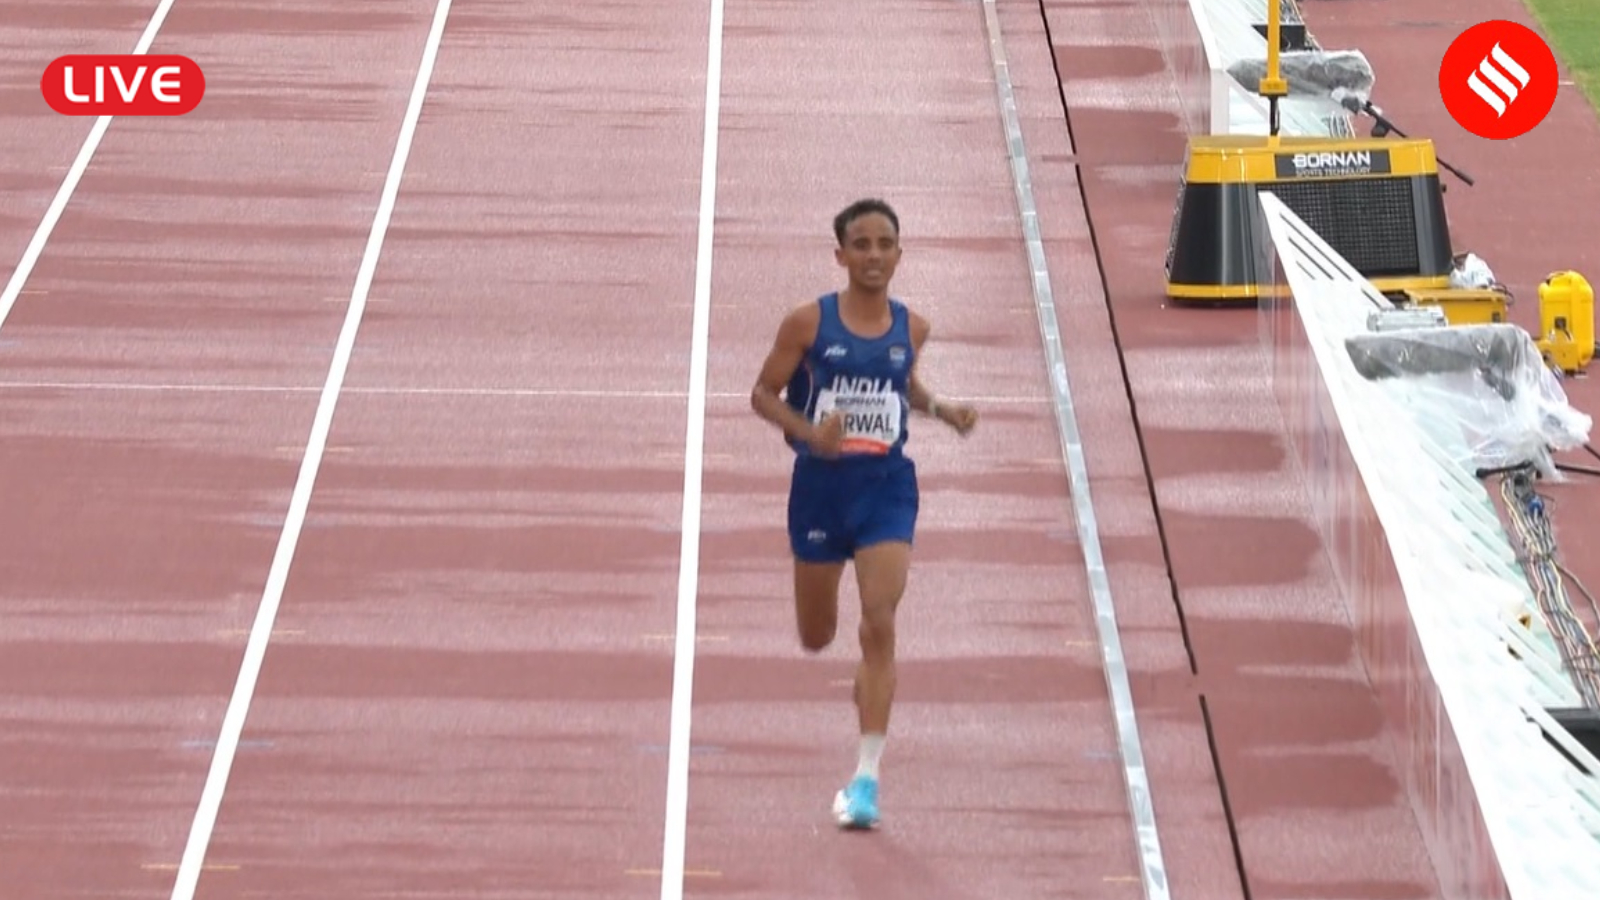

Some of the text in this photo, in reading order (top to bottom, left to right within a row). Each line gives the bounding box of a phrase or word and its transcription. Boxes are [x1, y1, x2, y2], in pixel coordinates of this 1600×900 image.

[1292, 150, 1371, 168] BORNAN
[831, 375, 892, 397] INDIA
[820, 411, 895, 434] RWAL
